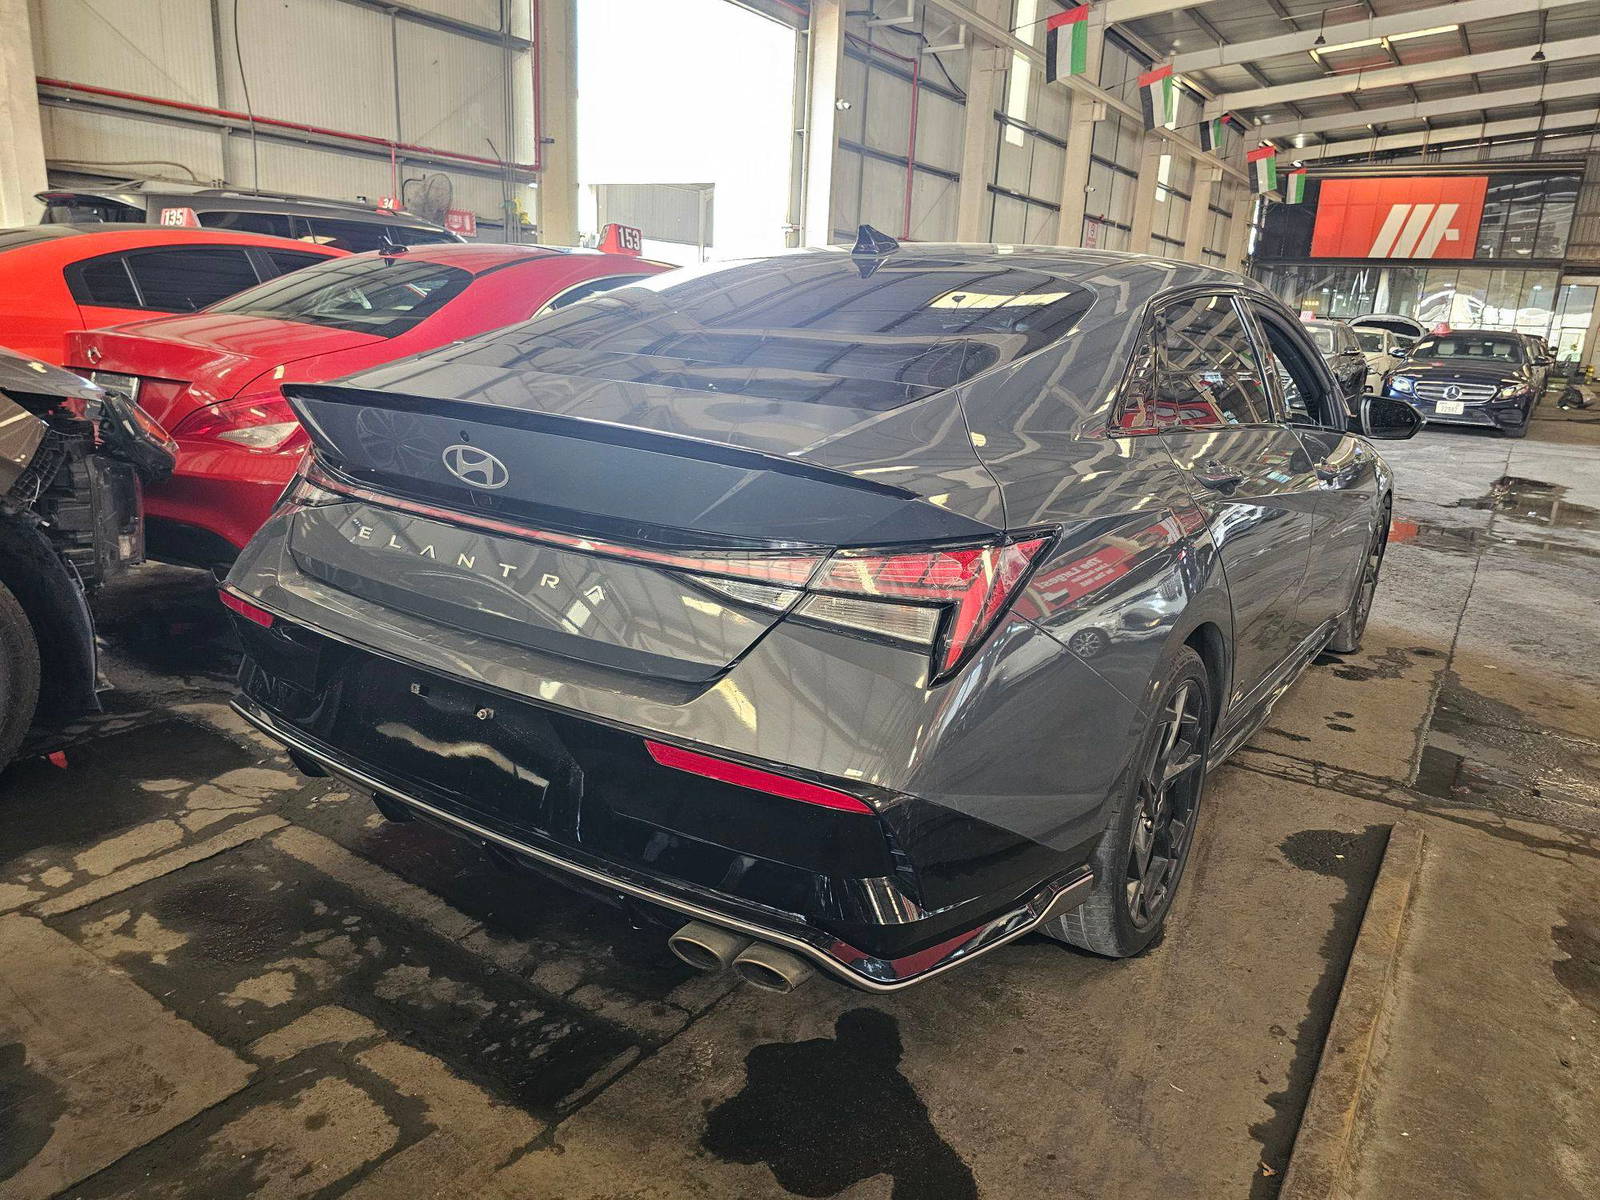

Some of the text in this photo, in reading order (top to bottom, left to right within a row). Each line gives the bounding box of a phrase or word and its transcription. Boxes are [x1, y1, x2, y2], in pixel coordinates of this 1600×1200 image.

[164, 209, 184, 226] 135
[618, 226, 641, 251] 153
[358, 526, 606, 601] ELANTRA
